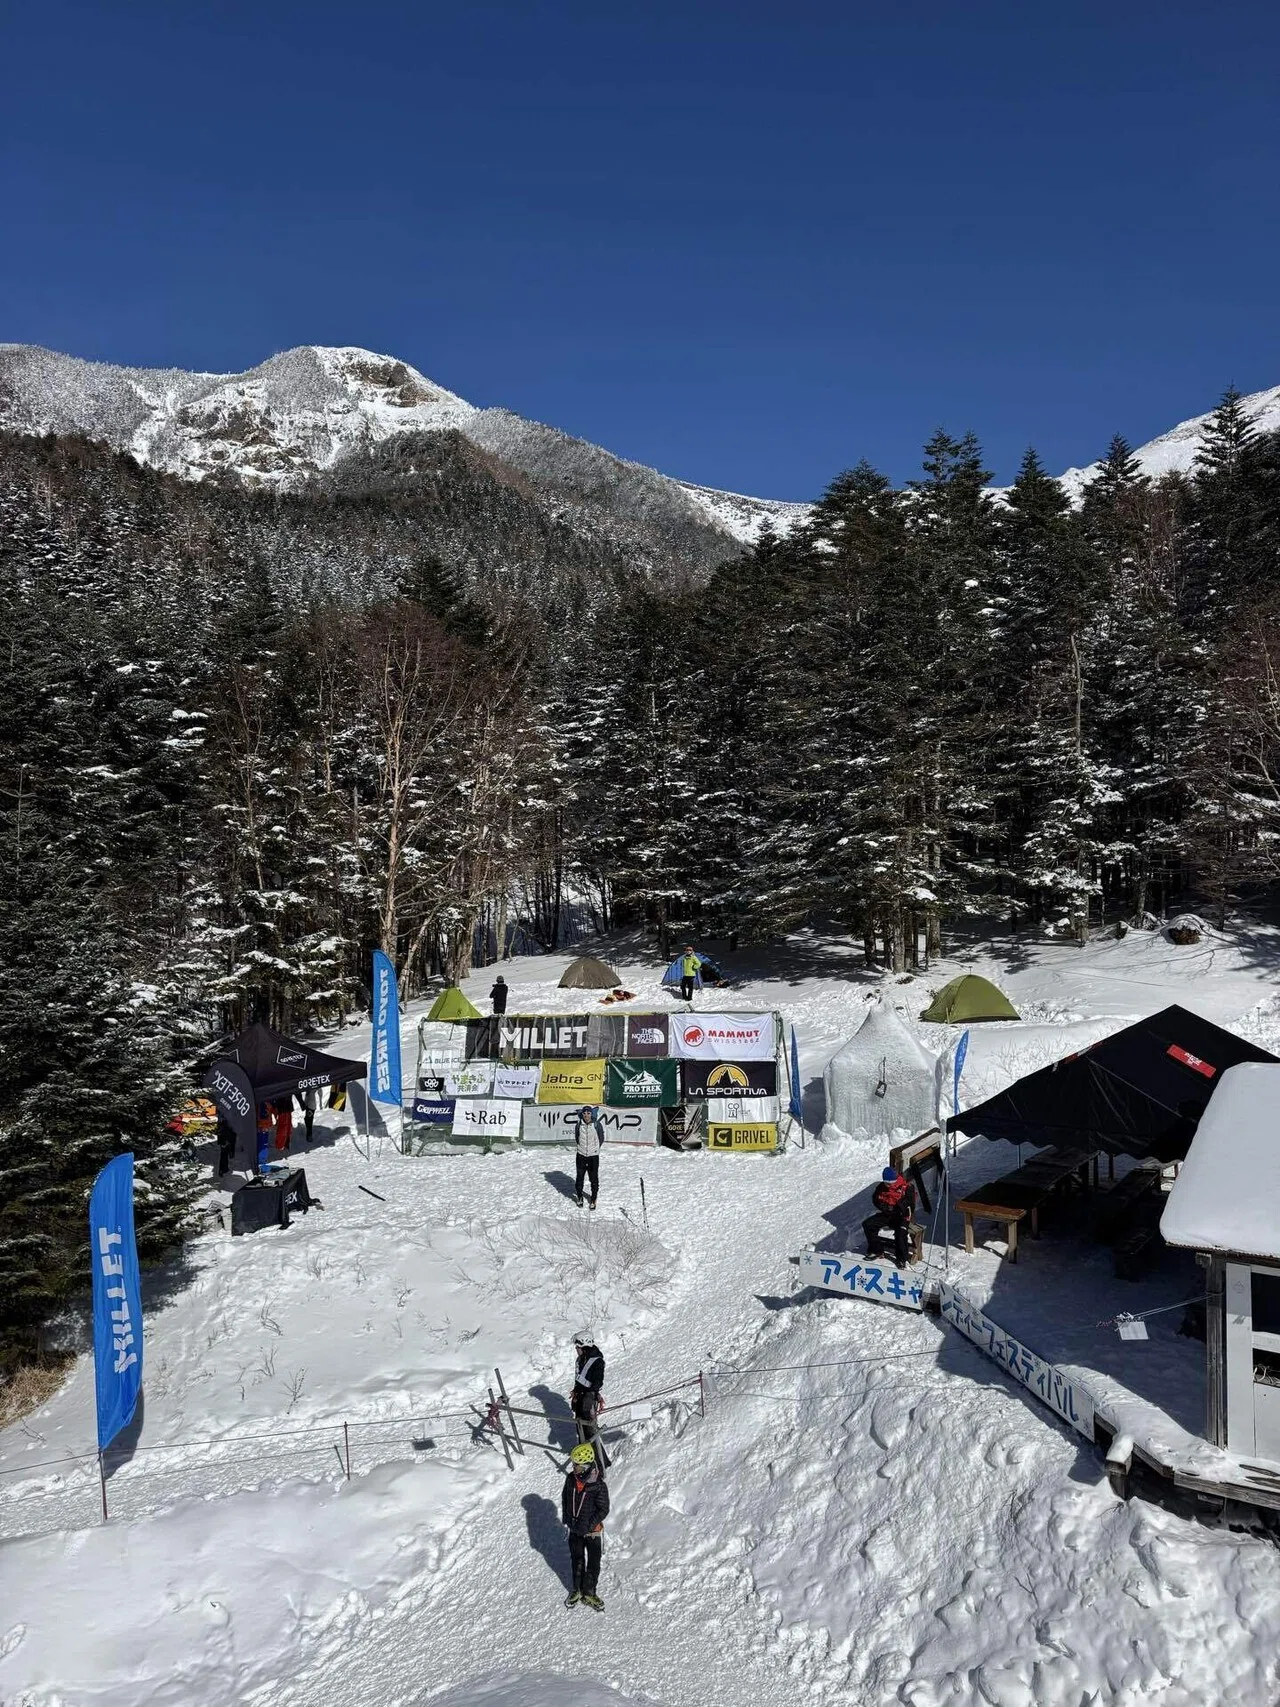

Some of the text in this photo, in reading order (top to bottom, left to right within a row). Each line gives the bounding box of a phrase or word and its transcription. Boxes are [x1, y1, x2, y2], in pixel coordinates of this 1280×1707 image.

[500, 1026, 588, 1049] MILLET
[708, 1030, 760, 1038] MAMMUT
[298, 1074, 331, 1090] GORE-TEX
[542, 1073, 602, 1084] Jabra GN
[624, 1085, 661, 1093] PRO TREK
[688, 1087, 768, 1096] LA SPORTIVA
[478, 1110, 507, 1125] Rab
[563, 1111, 643, 1131] CMP
[734, 1129, 771, 1144] GRIVEL
[820, 1258, 923, 1305] アイスキャ
[98, 1227, 138, 1374] MILLET
[940, 1283, 1080, 1423] ンディーフェスティバル
